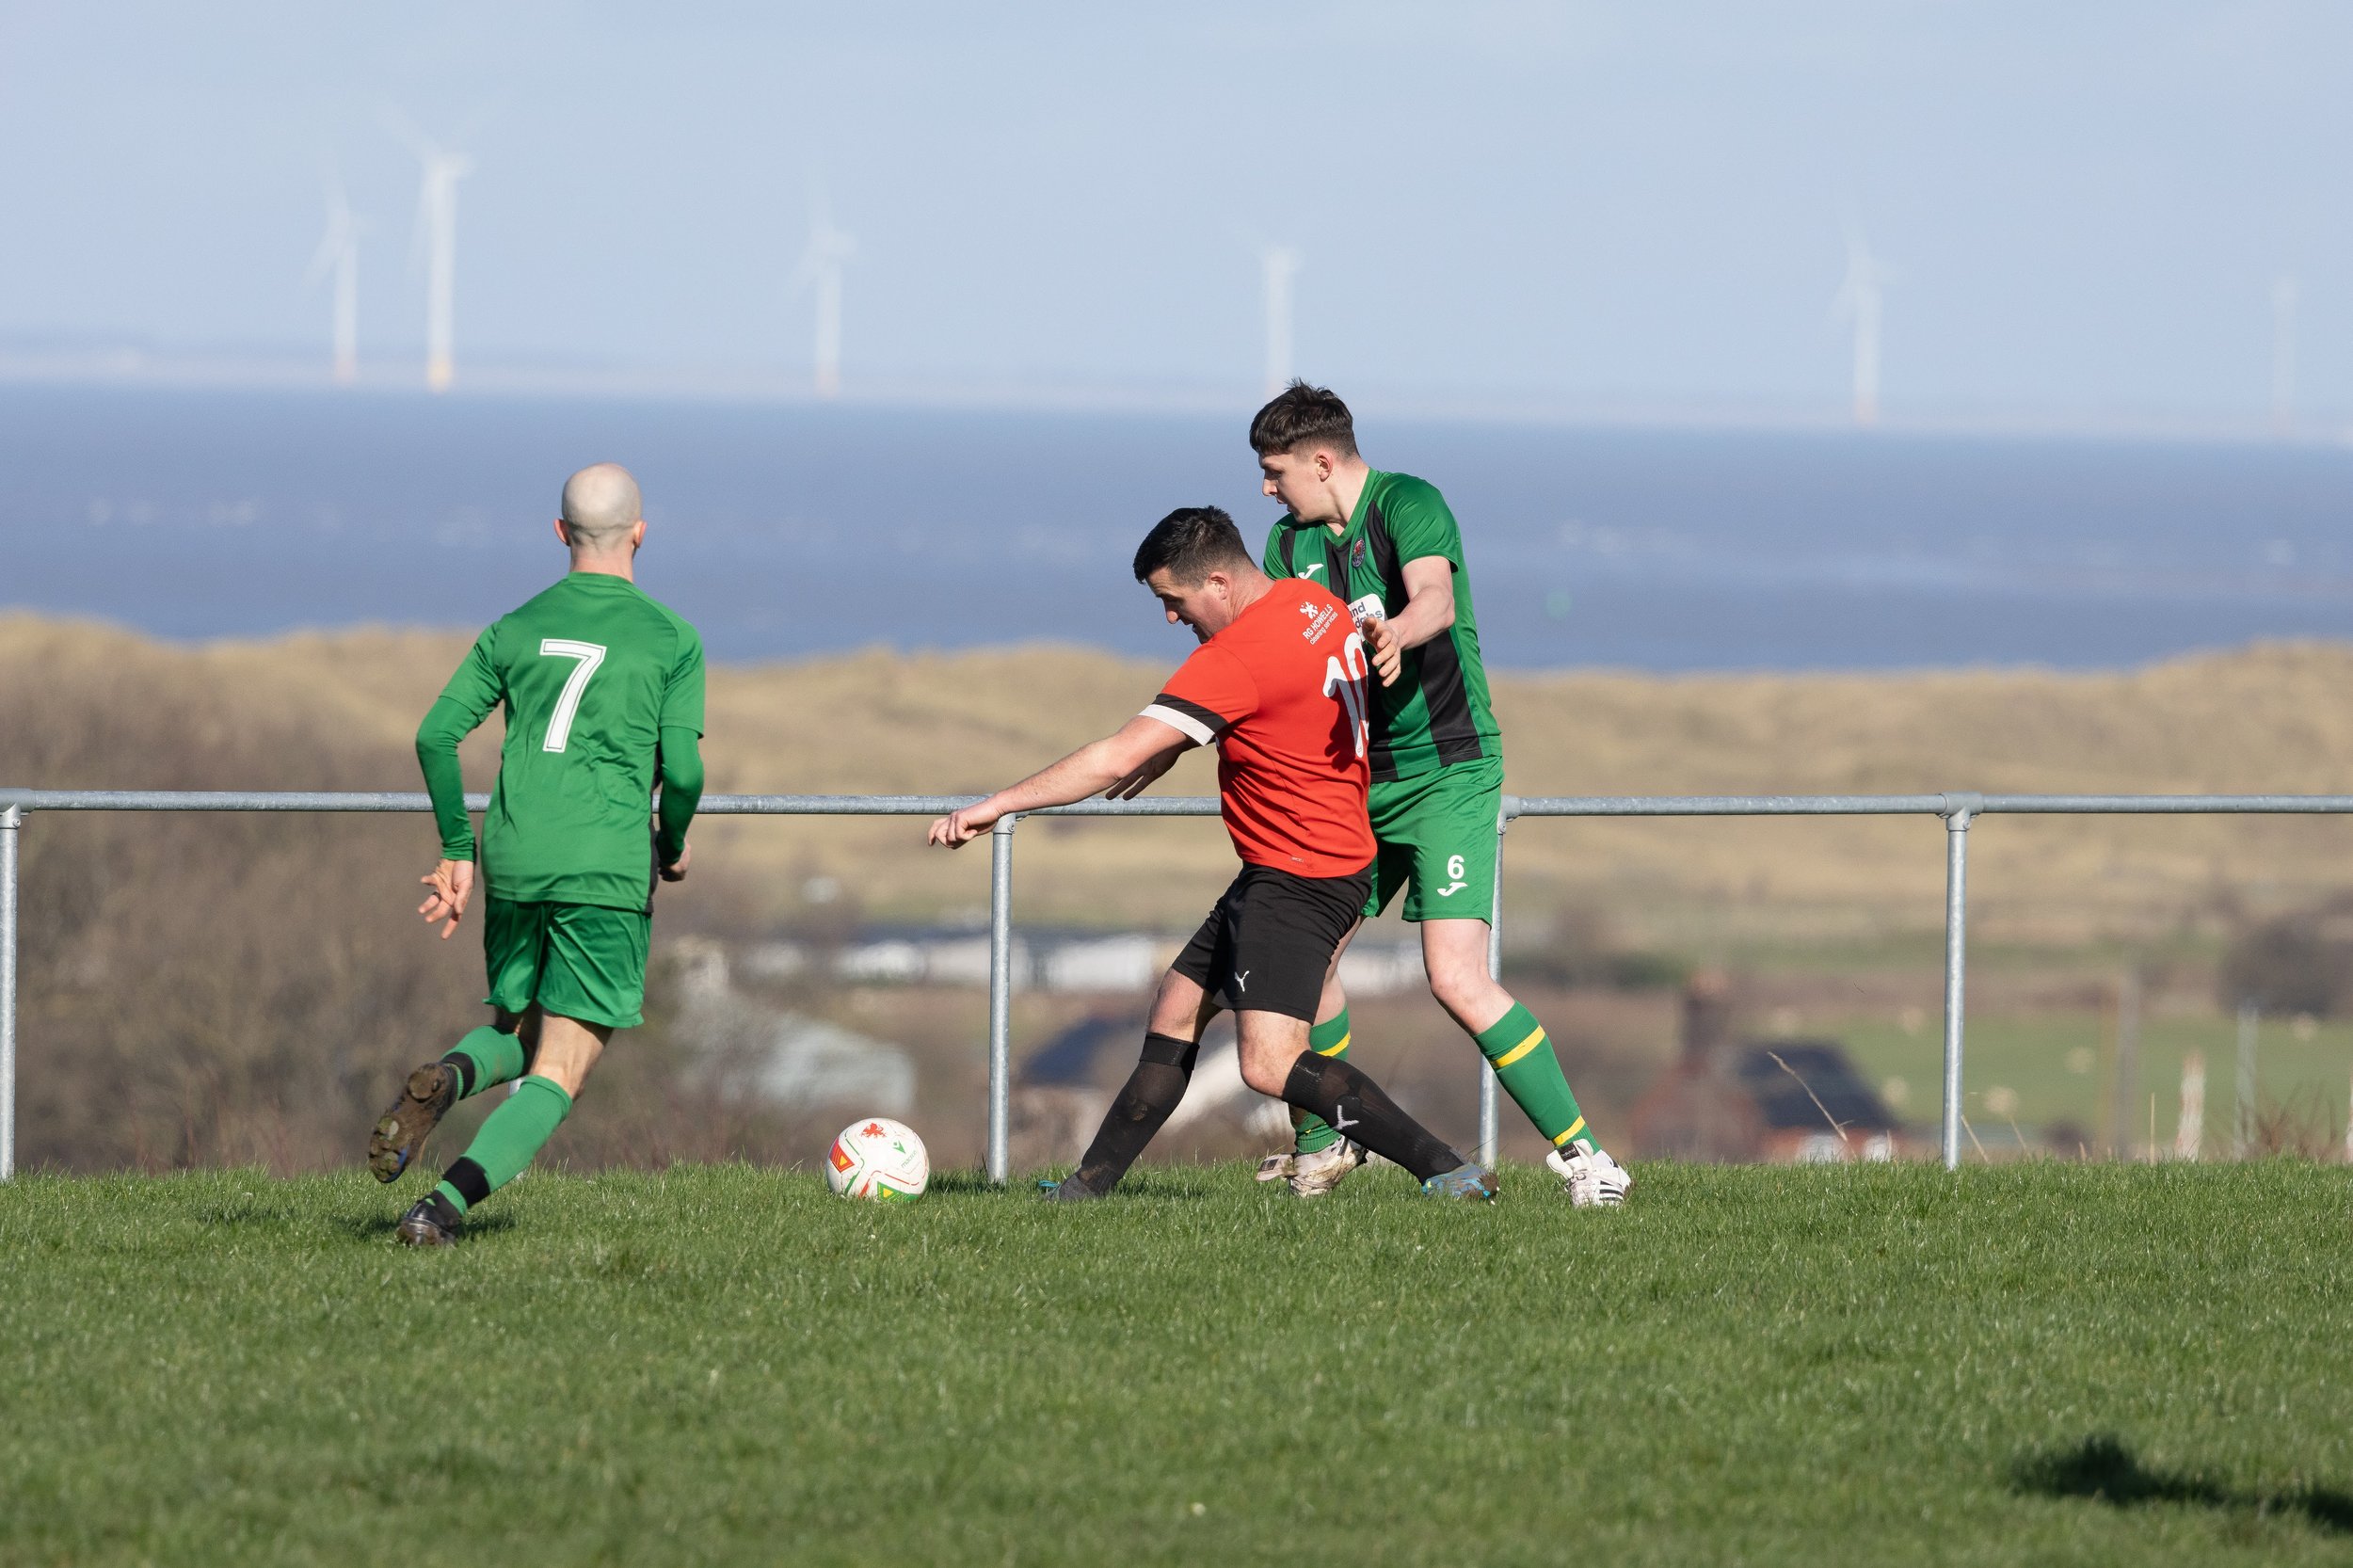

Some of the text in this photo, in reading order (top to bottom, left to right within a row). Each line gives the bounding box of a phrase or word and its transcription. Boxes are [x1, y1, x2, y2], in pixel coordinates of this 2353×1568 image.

[1303, 603, 1334, 640] RG HOWELLS
[1309, 611, 1338, 645] cleaning services
[539, 638, 608, 753] 7
[1322, 632, 1369, 758] 10
[1447, 855, 1465, 879] 6
